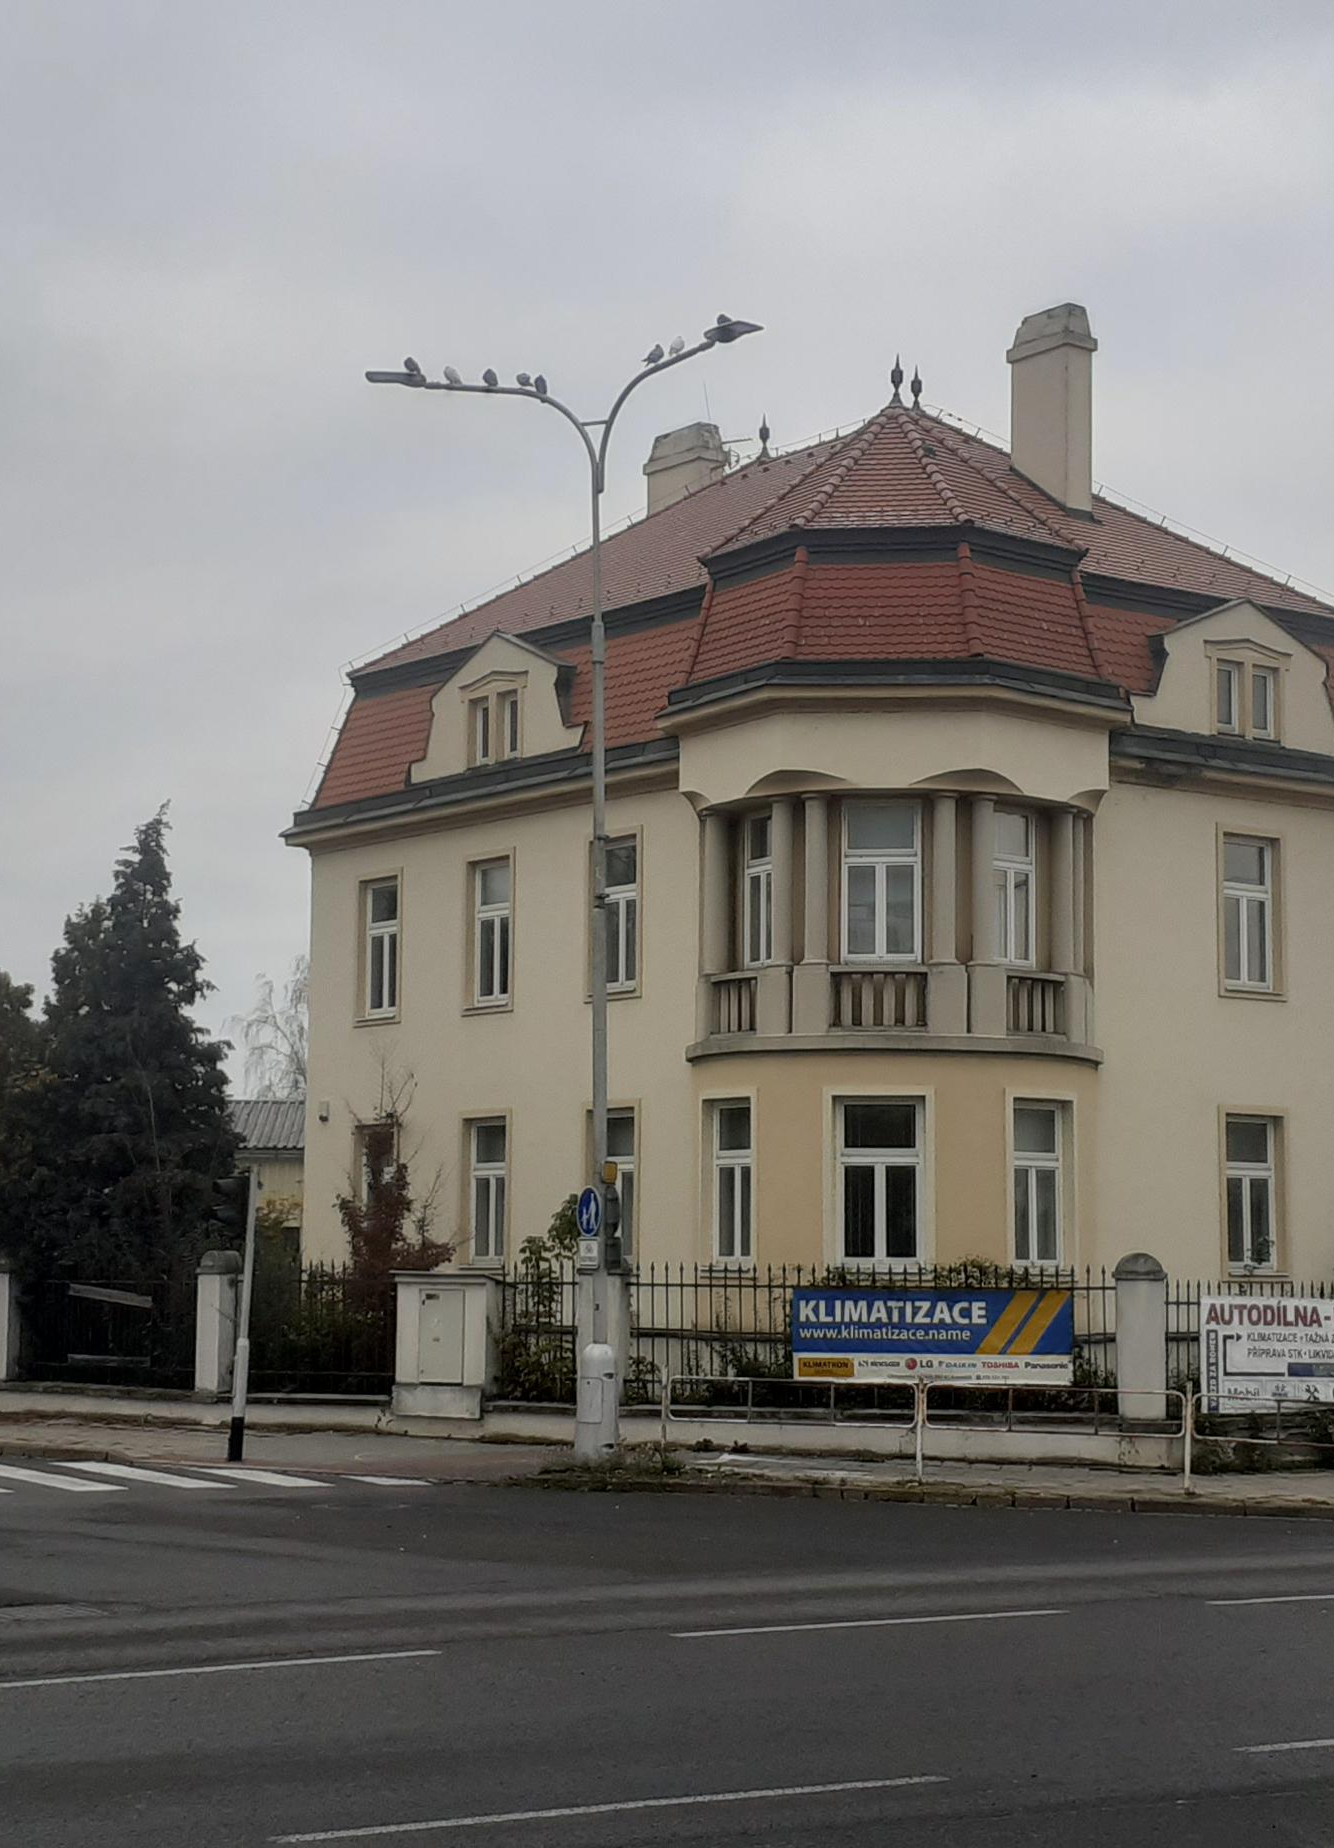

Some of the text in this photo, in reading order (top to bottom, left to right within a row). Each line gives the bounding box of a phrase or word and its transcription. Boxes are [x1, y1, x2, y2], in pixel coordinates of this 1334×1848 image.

[799, 1299, 988, 1324] KLIMATIZACE
[799, 1324, 971, 1342] www.klimatizace.name
[1246, 1332, 1299, 1343] KLIMATIZACE
[1287, 1348, 1303, 1359] STK
[919, 1359, 934, 1369] LG
[981, 1360, 1020, 1369] TOSHIBA
[1024, 1361, 1069, 1370] Panasonic
